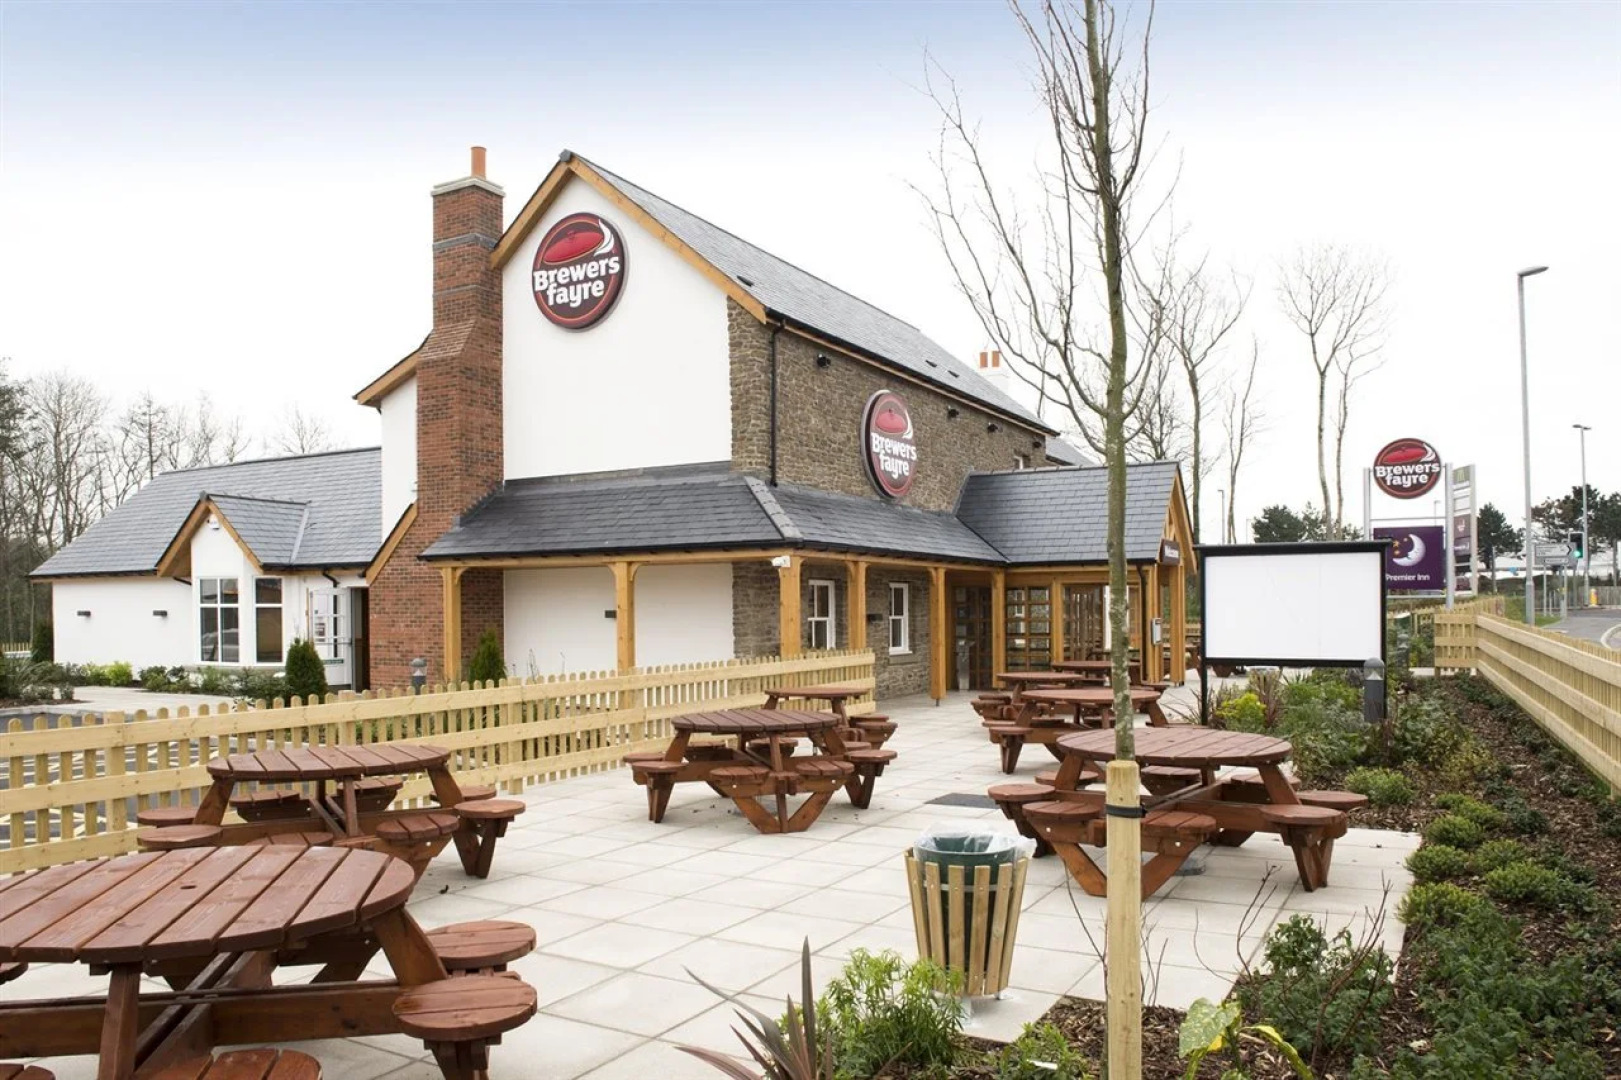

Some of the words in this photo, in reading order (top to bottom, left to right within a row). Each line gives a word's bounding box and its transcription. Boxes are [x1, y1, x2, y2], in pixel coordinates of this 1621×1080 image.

[533, 256, 620, 291] Brewers
[547, 279, 605, 308] fayre
[871, 432, 917, 461] Brewers
[879, 450, 909, 479] fayre
[1375, 463, 1440, 477] Brewers
[1385, 473, 1429, 488] fayre
[1386, 573, 1416, 581] Premier
[1417, 573, 1430, 581] Inn
